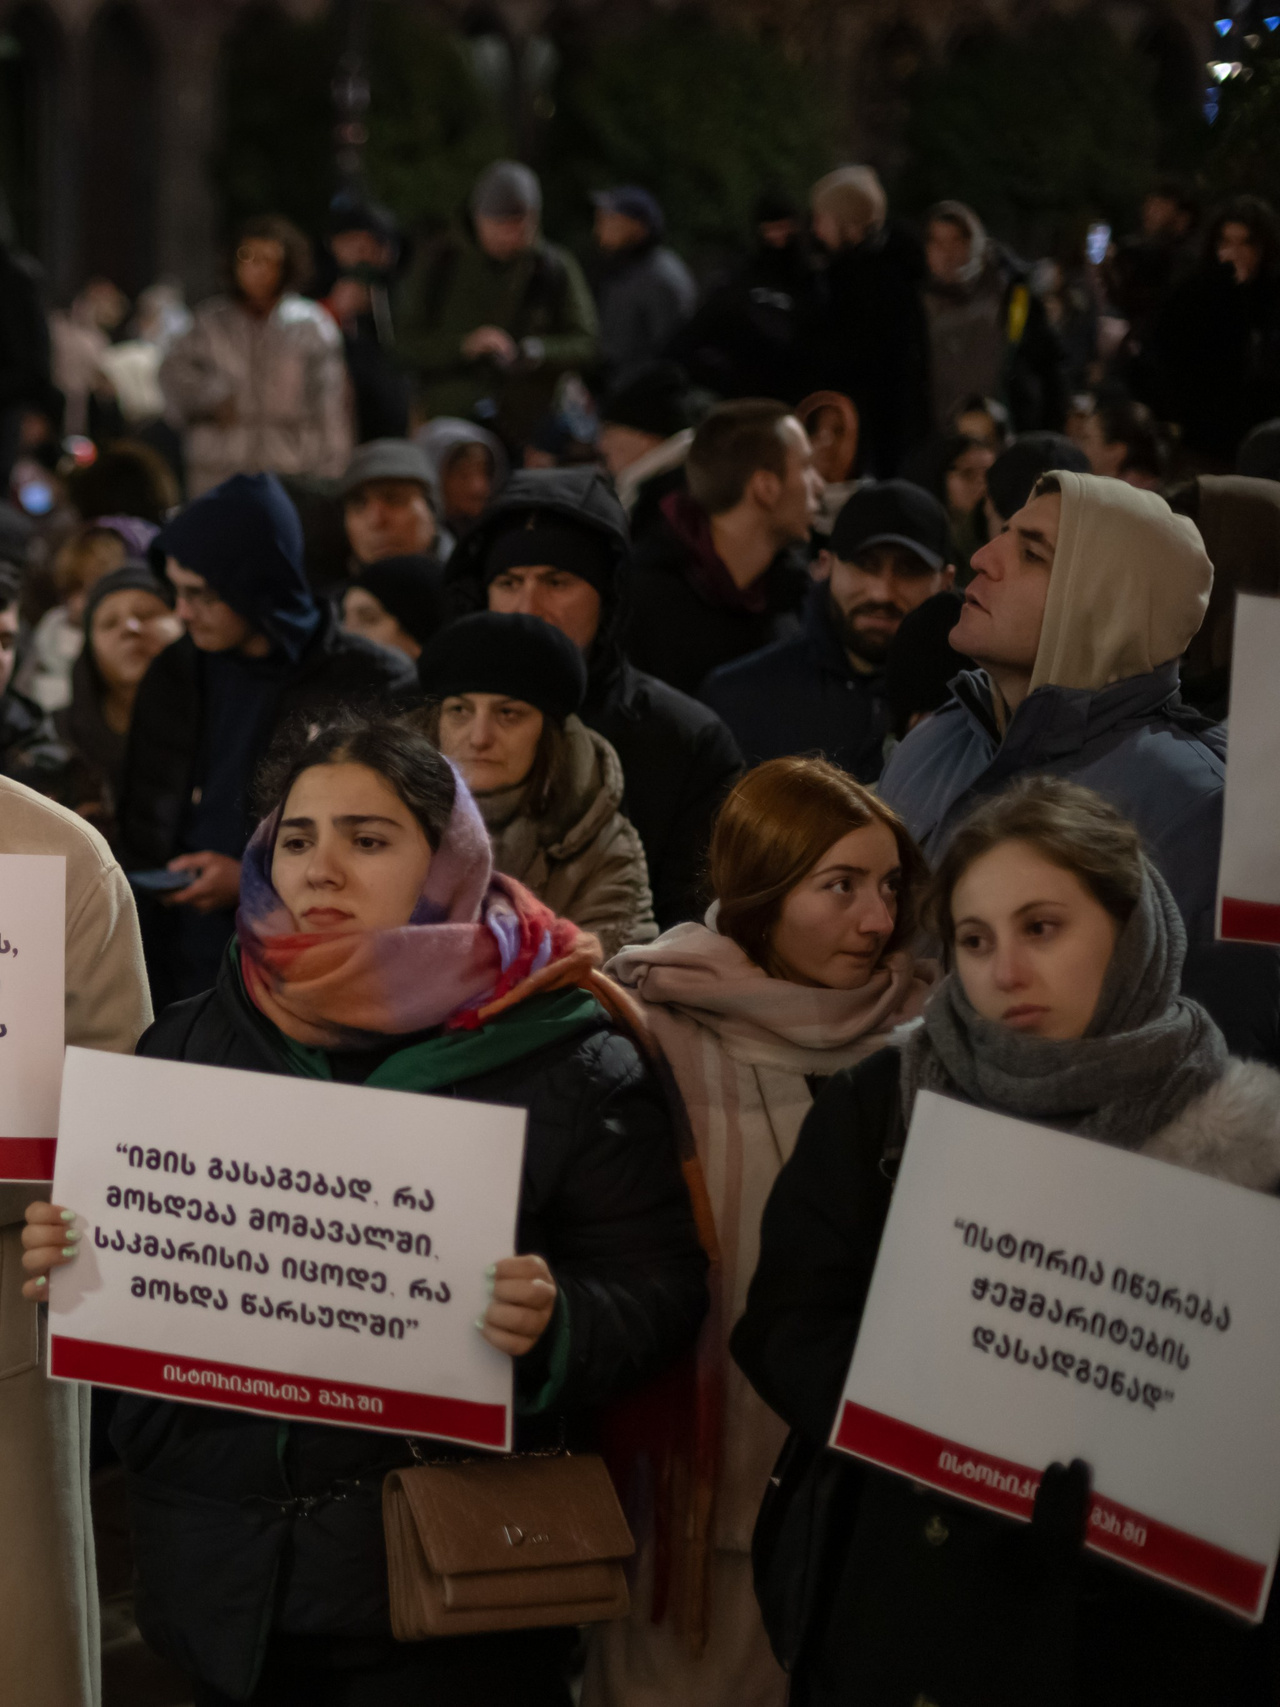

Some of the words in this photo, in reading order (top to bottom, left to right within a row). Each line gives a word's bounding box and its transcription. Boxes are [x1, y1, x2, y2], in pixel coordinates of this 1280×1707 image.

[106, 1185, 237, 1227] მოხდება
[116, 1143, 196, 1176] “იმის
[392, 1186, 435, 1212] რა
[94, 1226, 269, 1275] საკმარისია
[409, 1278, 452, 1304] რა
[954, 1219, 1105, 1286] “ისტორია
[1111, 1267, 1231, 1332] იწერება
[131, 1276, 228, 1311] მოხდა
[241, 1292, 419, 1340] წარსულში”
[971, 1277, 1189, 1371] ჭეშმარიტების
[164, 1365, 310, 1402] ისტორიკოსთა
[319, 1390, 383, 1413] მარში
[938, 1450, 1040, 1500] ისტორიკ
